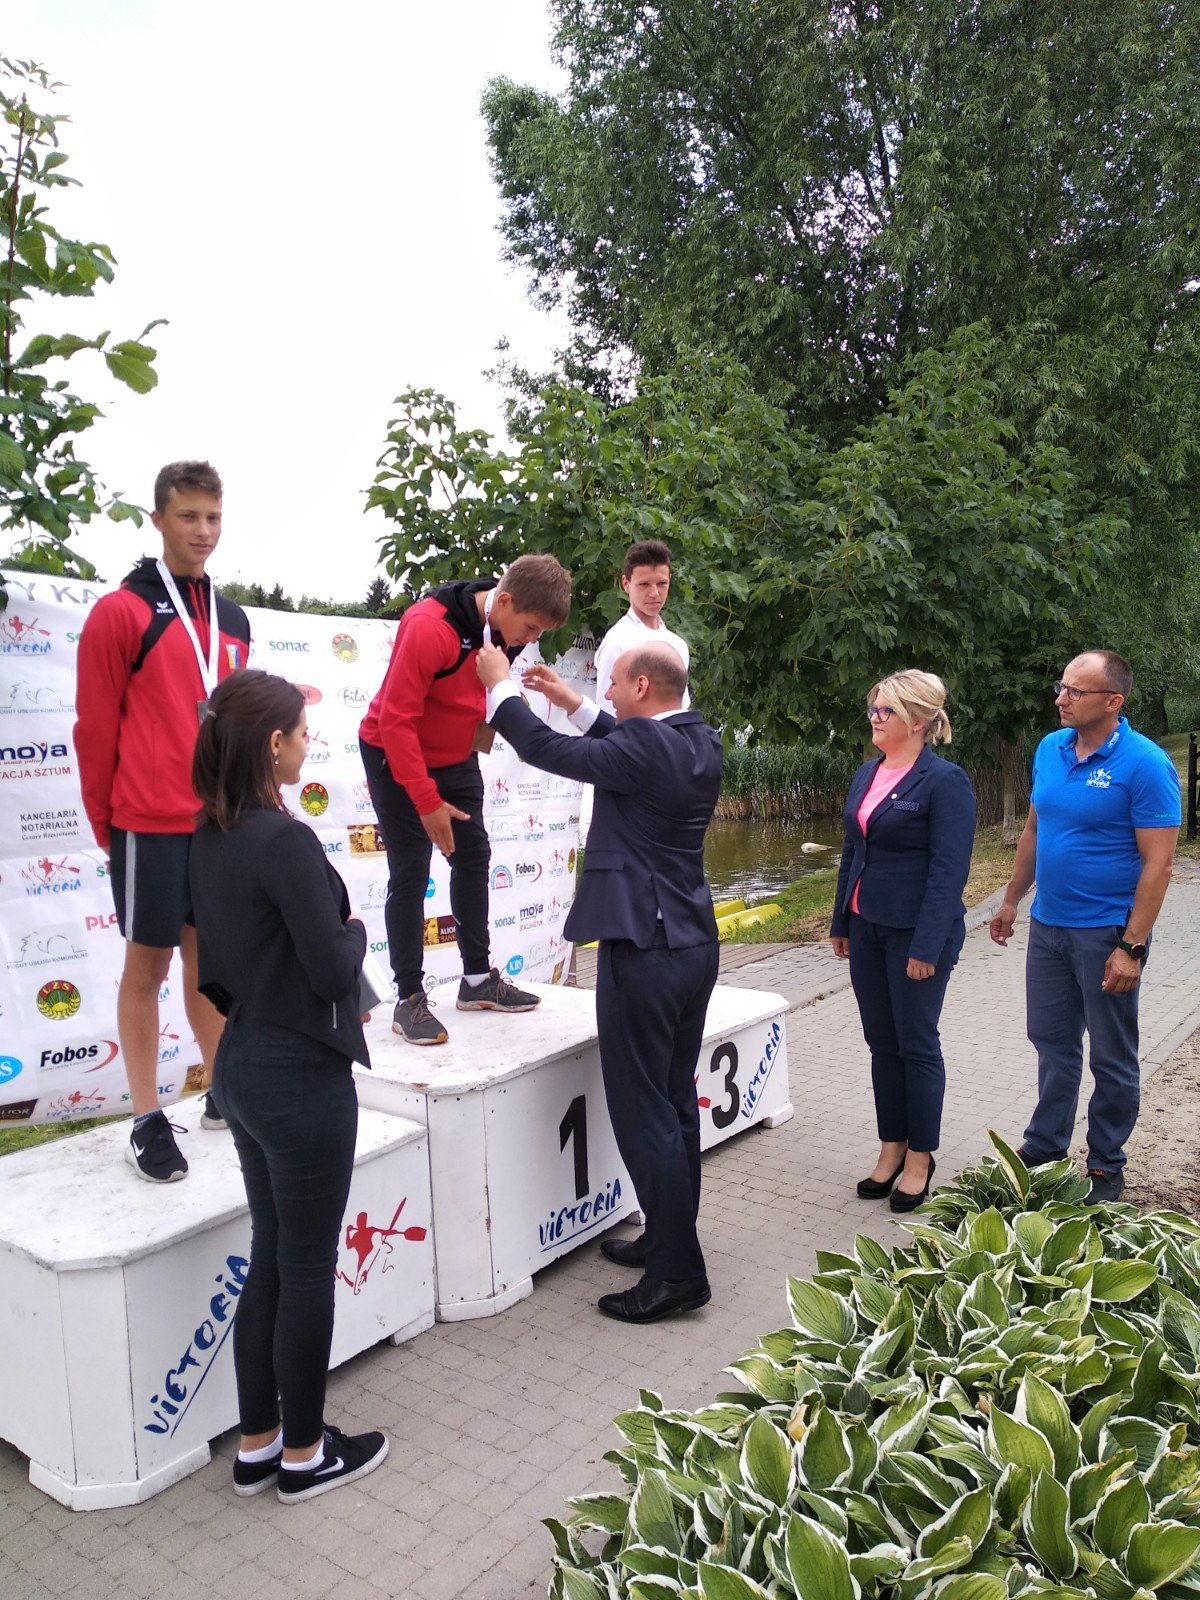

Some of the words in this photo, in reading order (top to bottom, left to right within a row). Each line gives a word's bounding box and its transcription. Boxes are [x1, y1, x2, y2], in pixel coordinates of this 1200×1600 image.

[269, 641, 310, 652] sonac
[34, 767, 71, 777] SZTUM
[20, 809, 77, 822] KANCELARIA
[21, 820, 79, 832] NOTARIALNA
[516, 863, 535, 875] Fobos
[495, 916, 516, 928] sonac
[42, 981, 70, 995] LZS
[40, 1045, 98, 1067] Fobos
[710, 1041, 739, 1129] 3
[559, 1094, 589, 1200] 1
